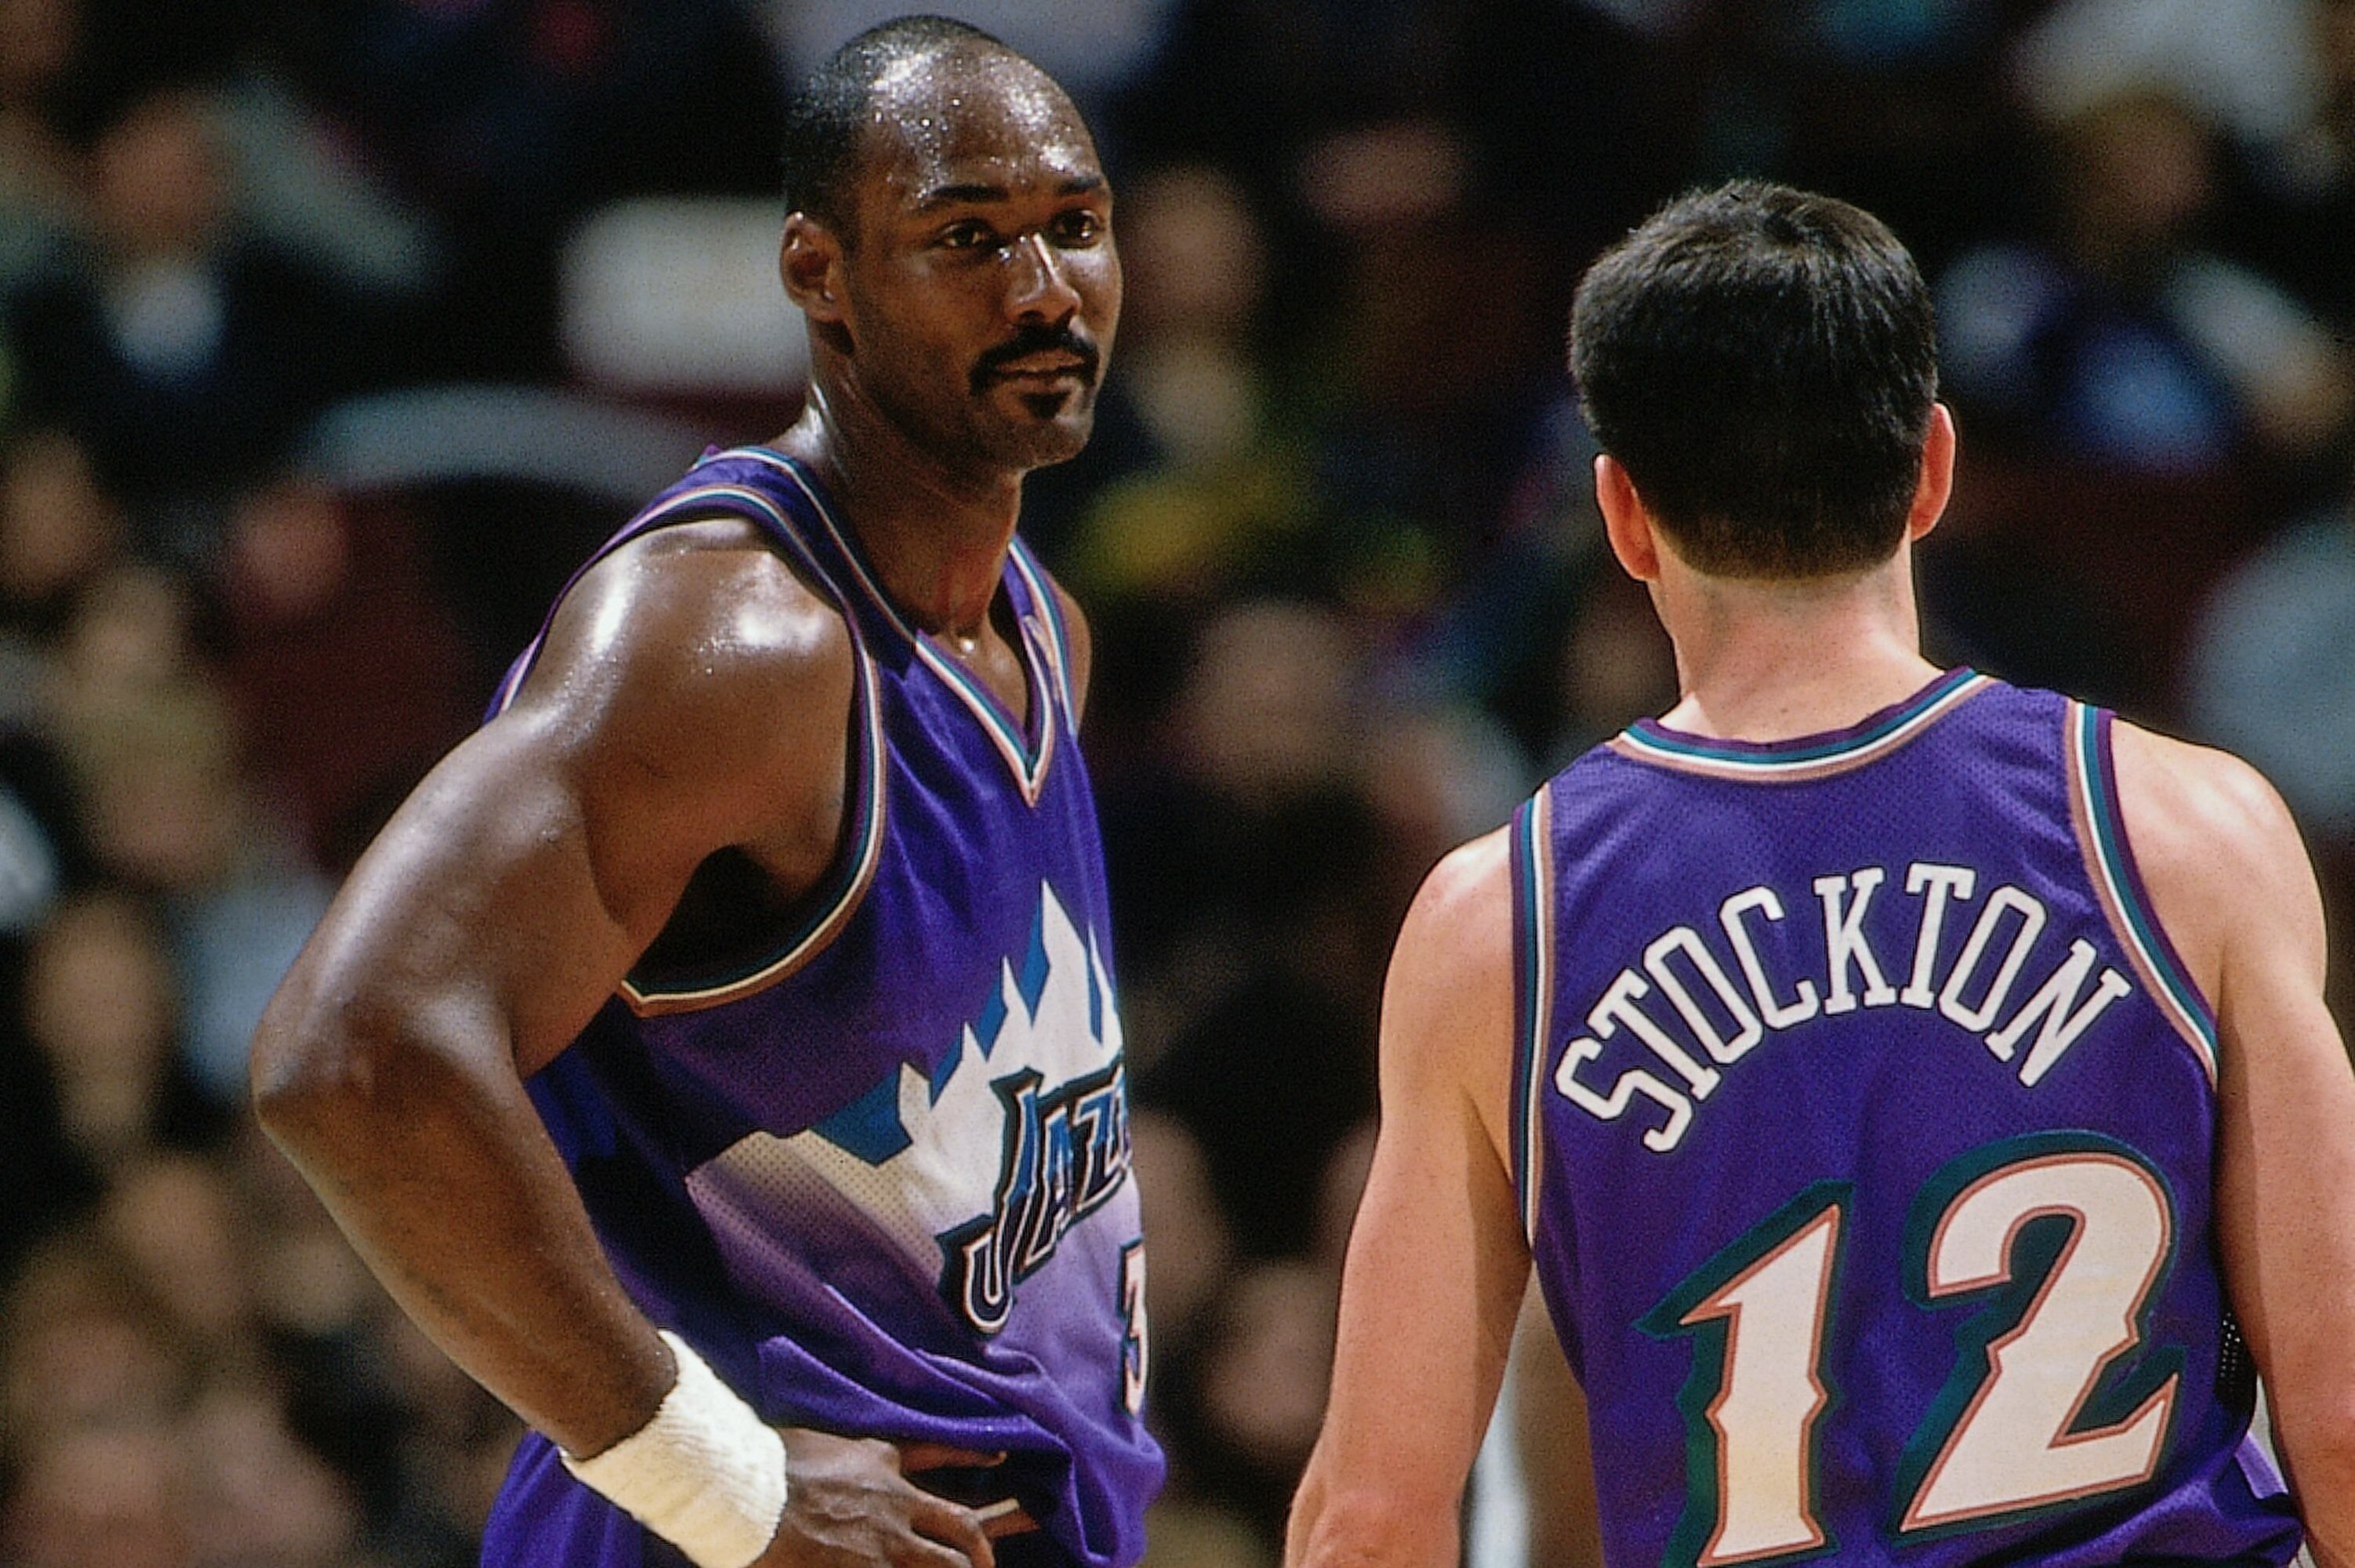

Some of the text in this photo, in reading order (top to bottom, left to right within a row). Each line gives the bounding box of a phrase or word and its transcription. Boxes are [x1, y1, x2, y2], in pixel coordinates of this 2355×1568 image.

[1554, 861, 2132, 1153] STOCKTON
[941, 1058, 1134, 1335] JAZ
[1646, 1137, 2183, 1568] 12
